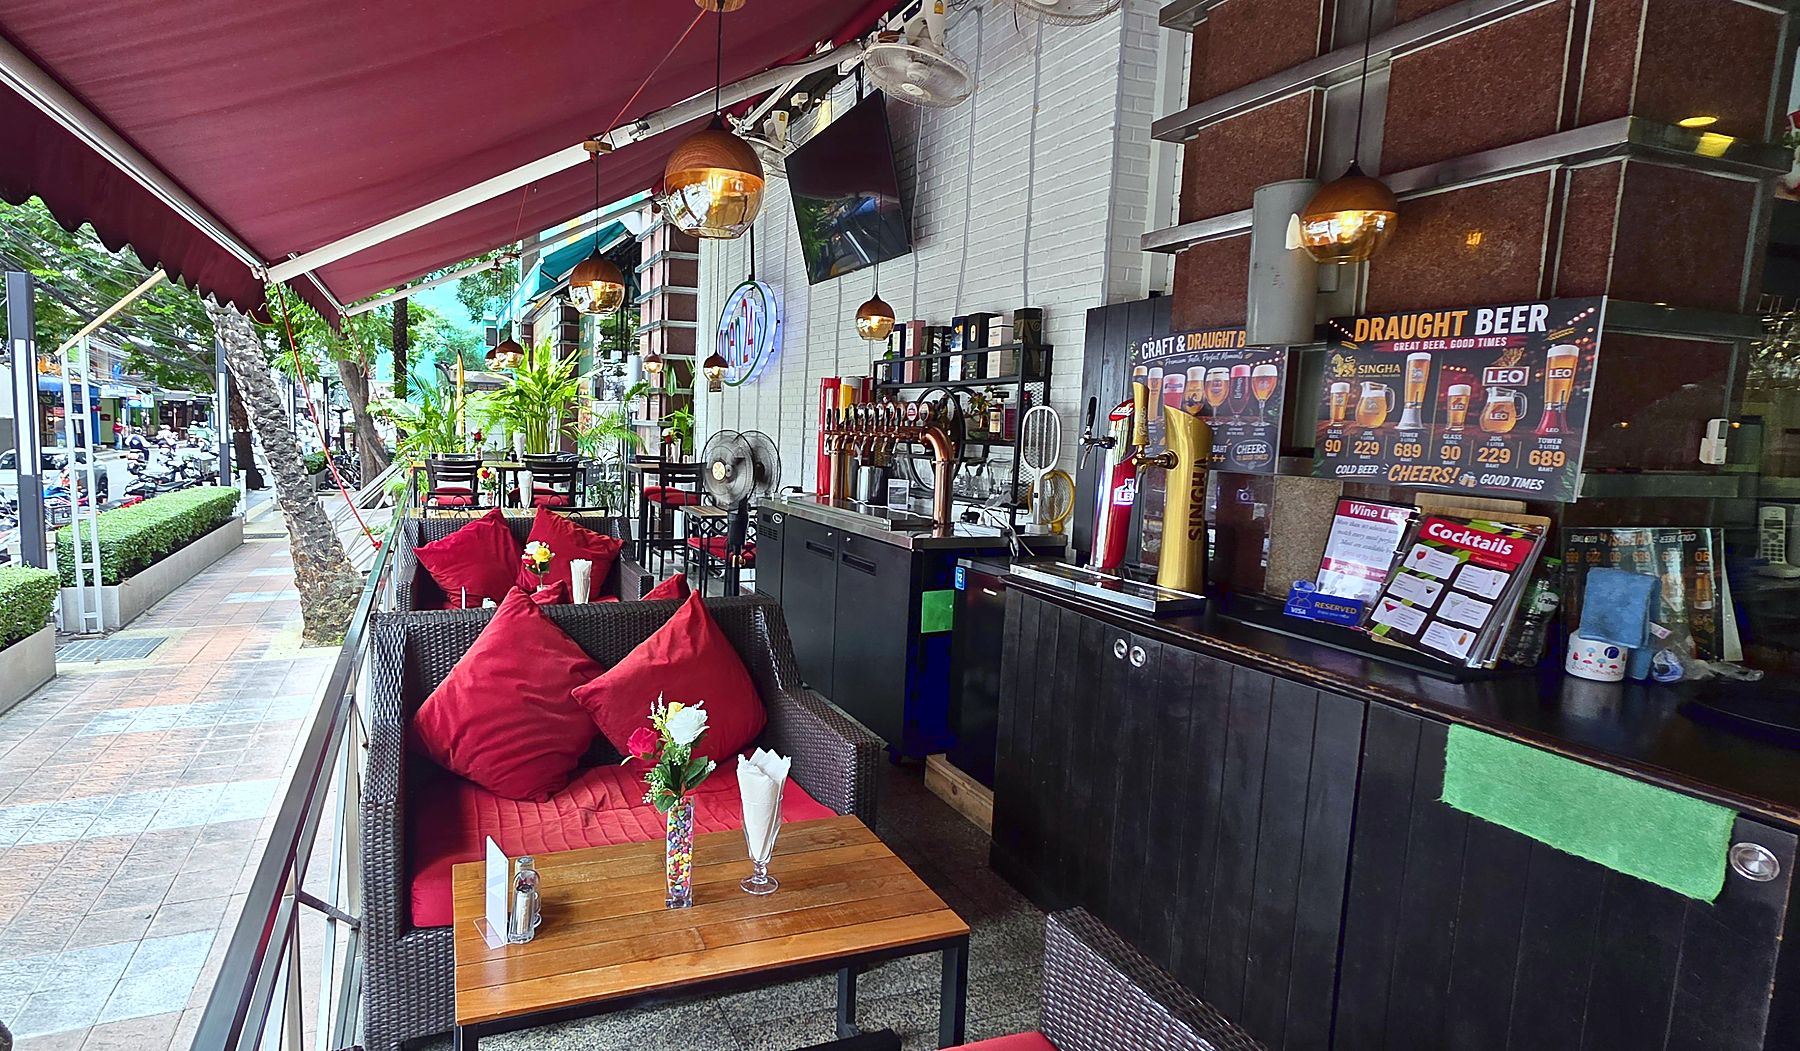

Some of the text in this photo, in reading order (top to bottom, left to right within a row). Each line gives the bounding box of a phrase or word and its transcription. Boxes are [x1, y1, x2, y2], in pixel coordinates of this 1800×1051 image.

[1354, 304, 1549, 342] DRAUGHT BEER
[1141, 336, 1175, 360] CRAFT
[1176, 335, 1186, 352] &
[1187, 330, 1236, 350] DRAUGHT
[1393, 341, 1419, 351] GREAT
[1450, 338, 1475, 349] GOOD
[1478, 337, 1508, 347] TIMES
[1358, 364, 1401, 374] SINGHA
[1486, 369, 1524, 384] LEO
[1548, 368, 1572, 378] LEO
[1489, 412, 1508, 420] LEO
[1325, 439, 1342, 453] 90
[1354, 441, 1380, 455] 229
[1538, 437, 1563, 445] TOWER
[1237, 444, 1267, 454] CHEERS
[1394, 442, 1422, 458] 689
[1440, 445, 1462, 460] 90
[1477, 447, 1511, 464] 229
[1529, 450, 1566, 467] 689
[1335, 464, 1379, 475] COLD BEER
[1388, 464, 1460, 483] CHEERS!
[1480, 473, 1545, 490] GOOD TIMES
[1188, 457, 1208, 542] SINGHA
[1349, 503, 1378, 518] Wine
[1428, 523, 1514, 555] Cocktails
[1290, 606, 1307, 615] VISA
[1314, 602, 1357, 615] RESERVED
